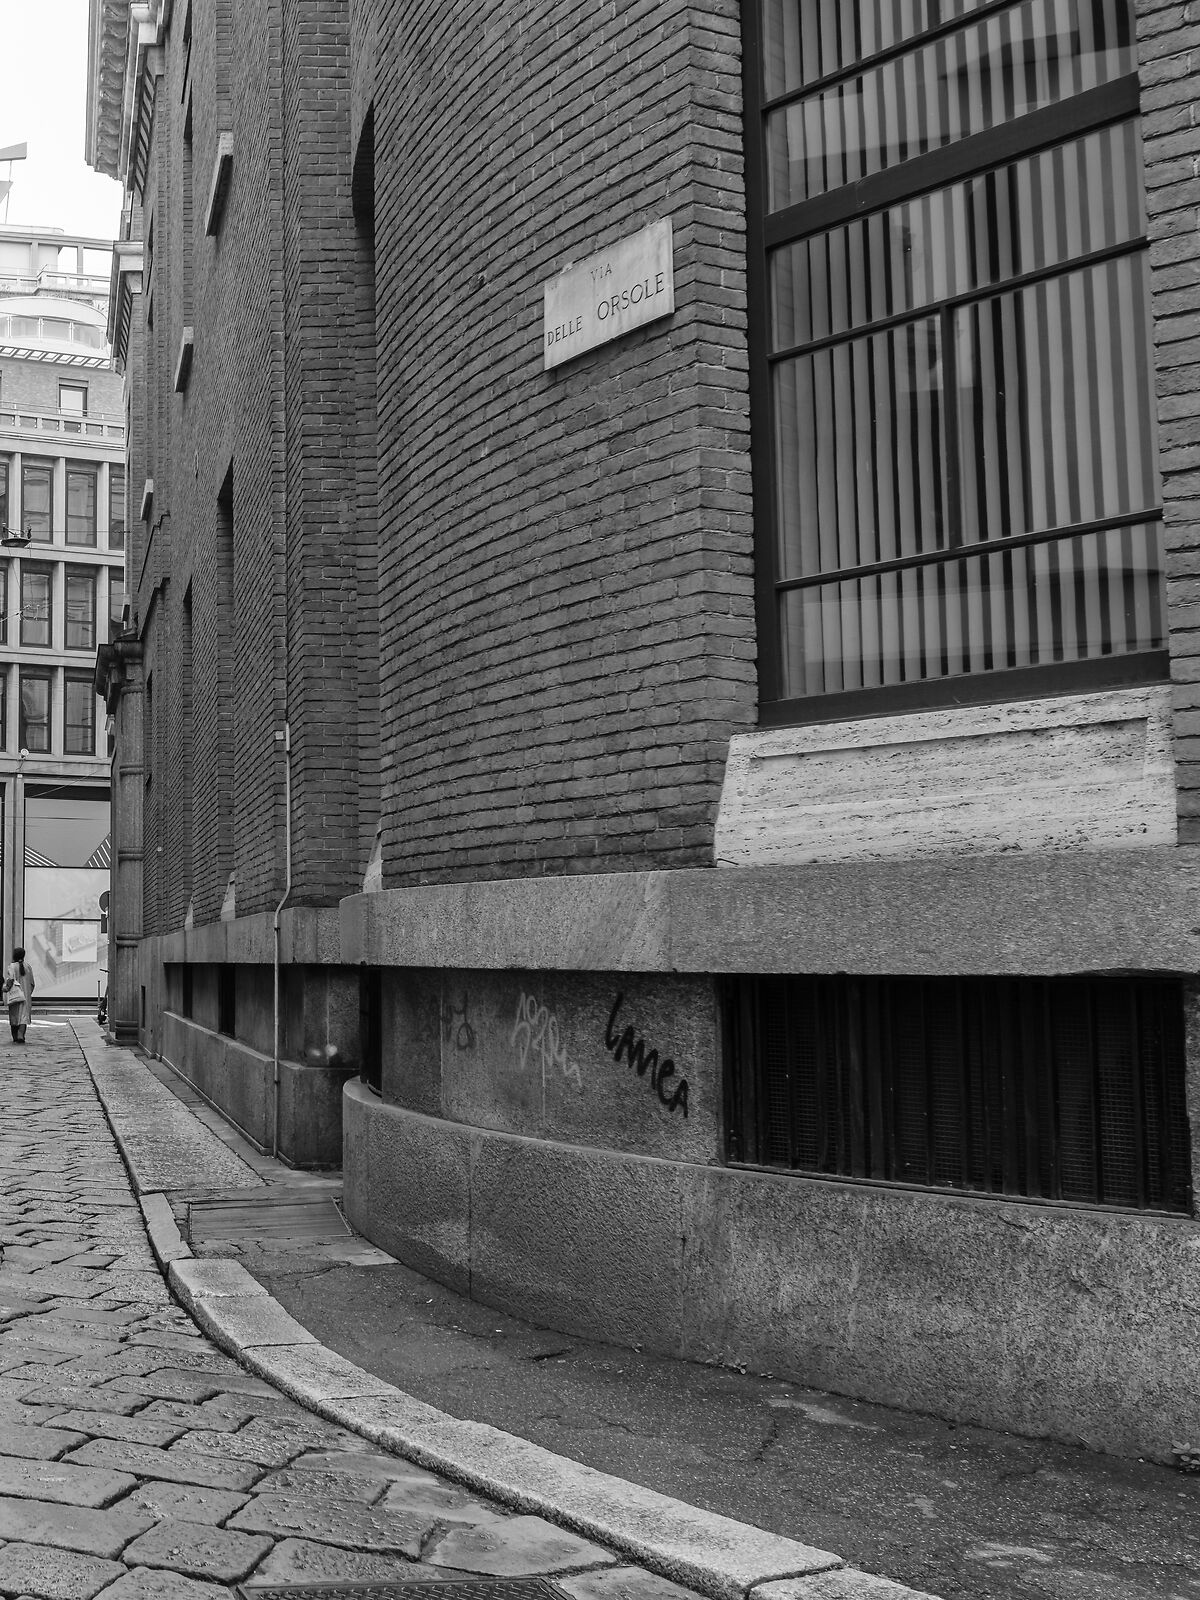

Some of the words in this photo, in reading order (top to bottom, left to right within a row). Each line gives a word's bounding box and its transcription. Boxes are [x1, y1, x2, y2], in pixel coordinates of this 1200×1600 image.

[590, 263, 613, 281] VIA
[547, 315, 583, 346] DELLE
[597, 272, 665, 320] ORSOLE
